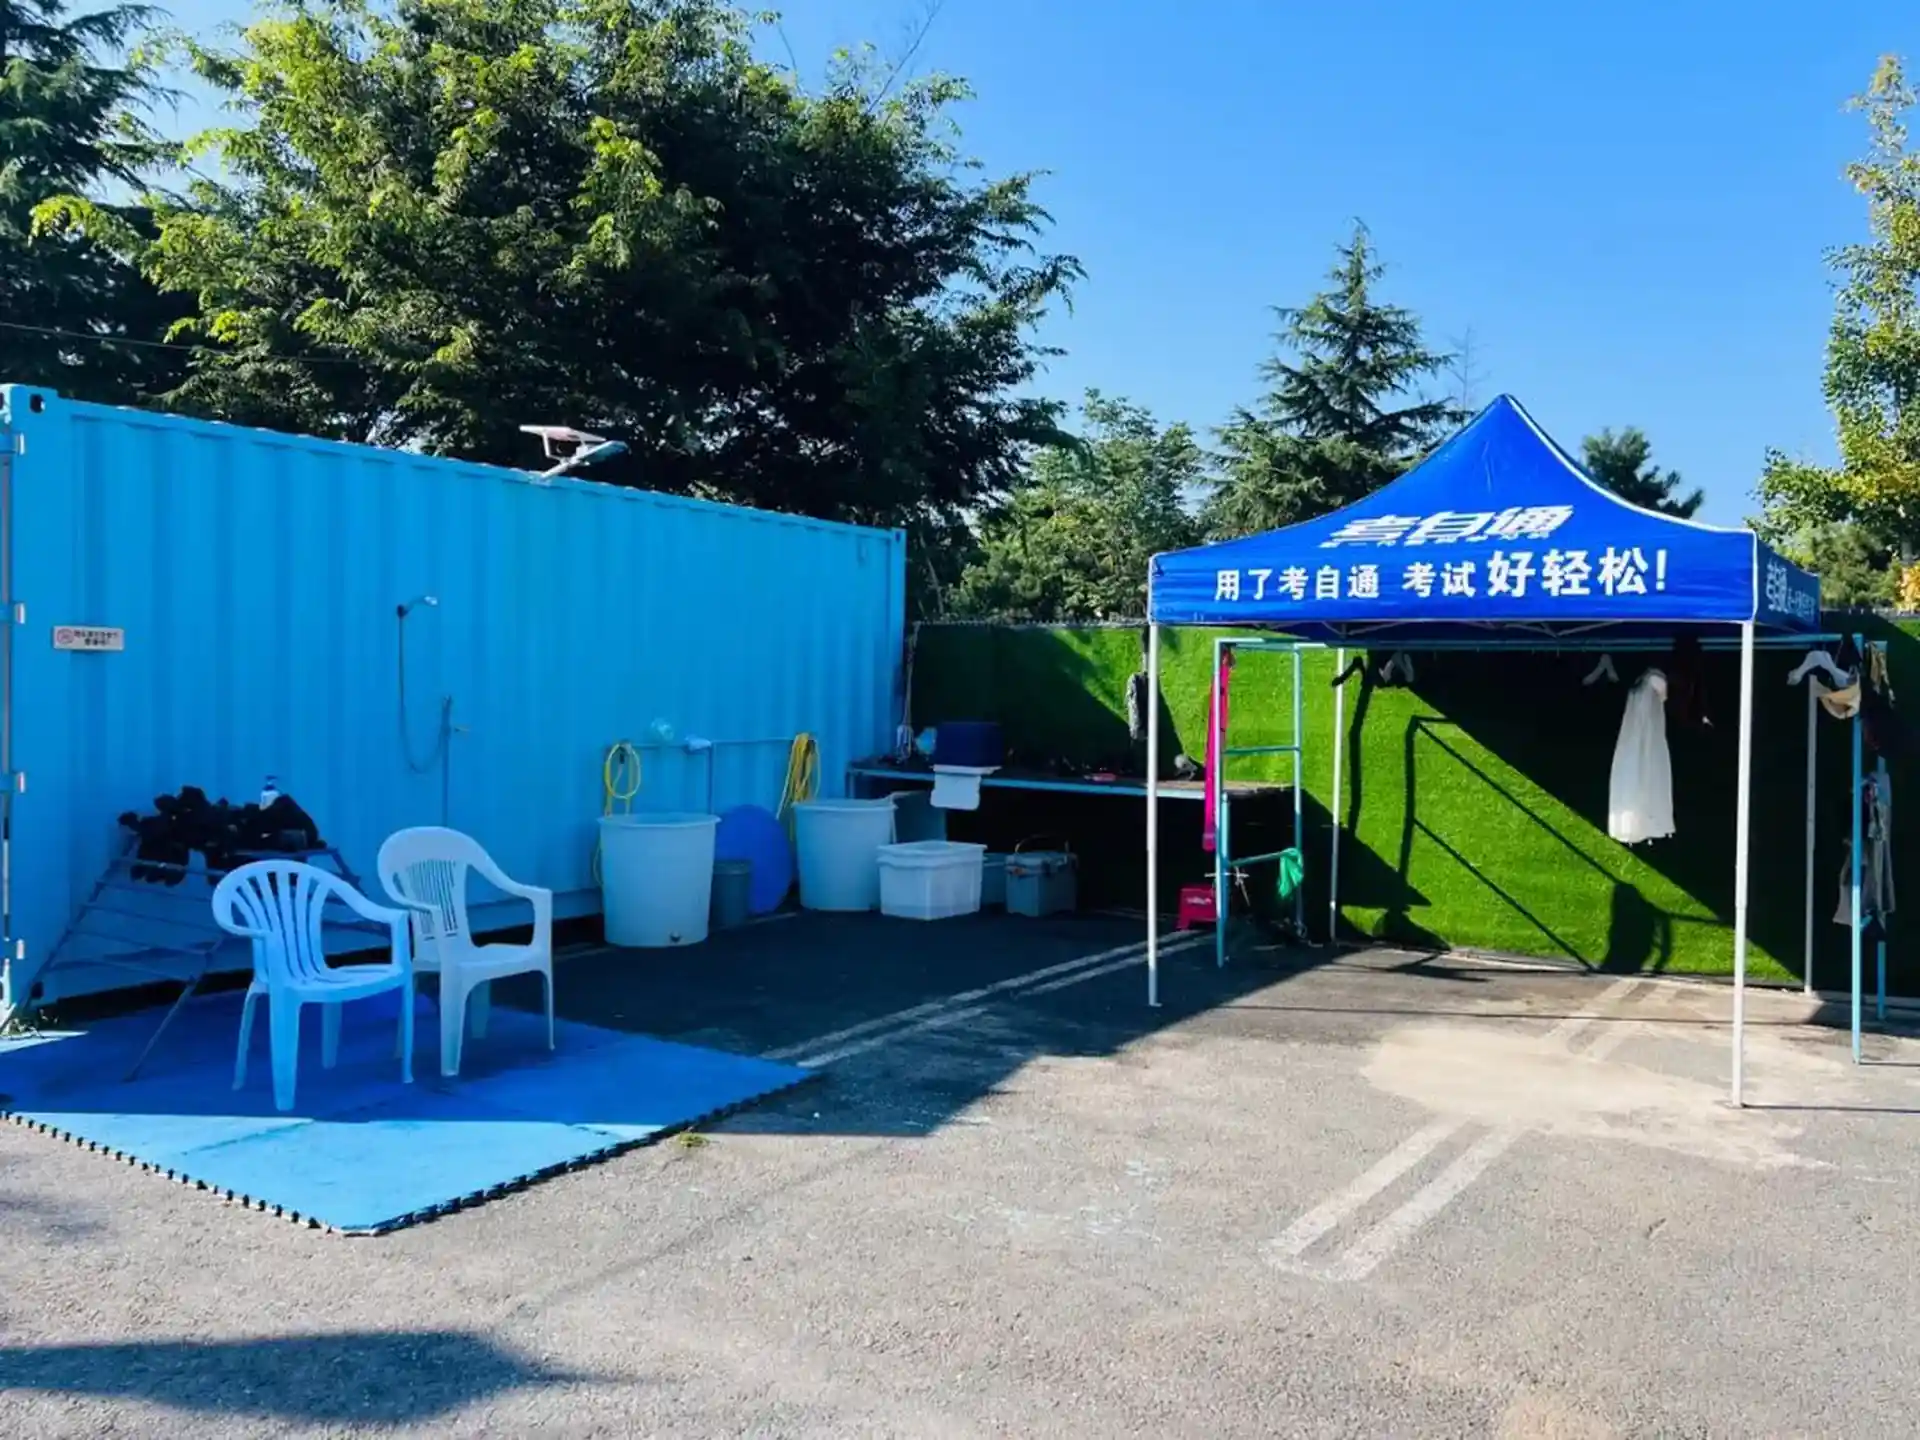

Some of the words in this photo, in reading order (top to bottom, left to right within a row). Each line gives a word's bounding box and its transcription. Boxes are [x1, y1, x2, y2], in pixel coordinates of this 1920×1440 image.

[1215, 564, 1380, 600] 用了考自通
